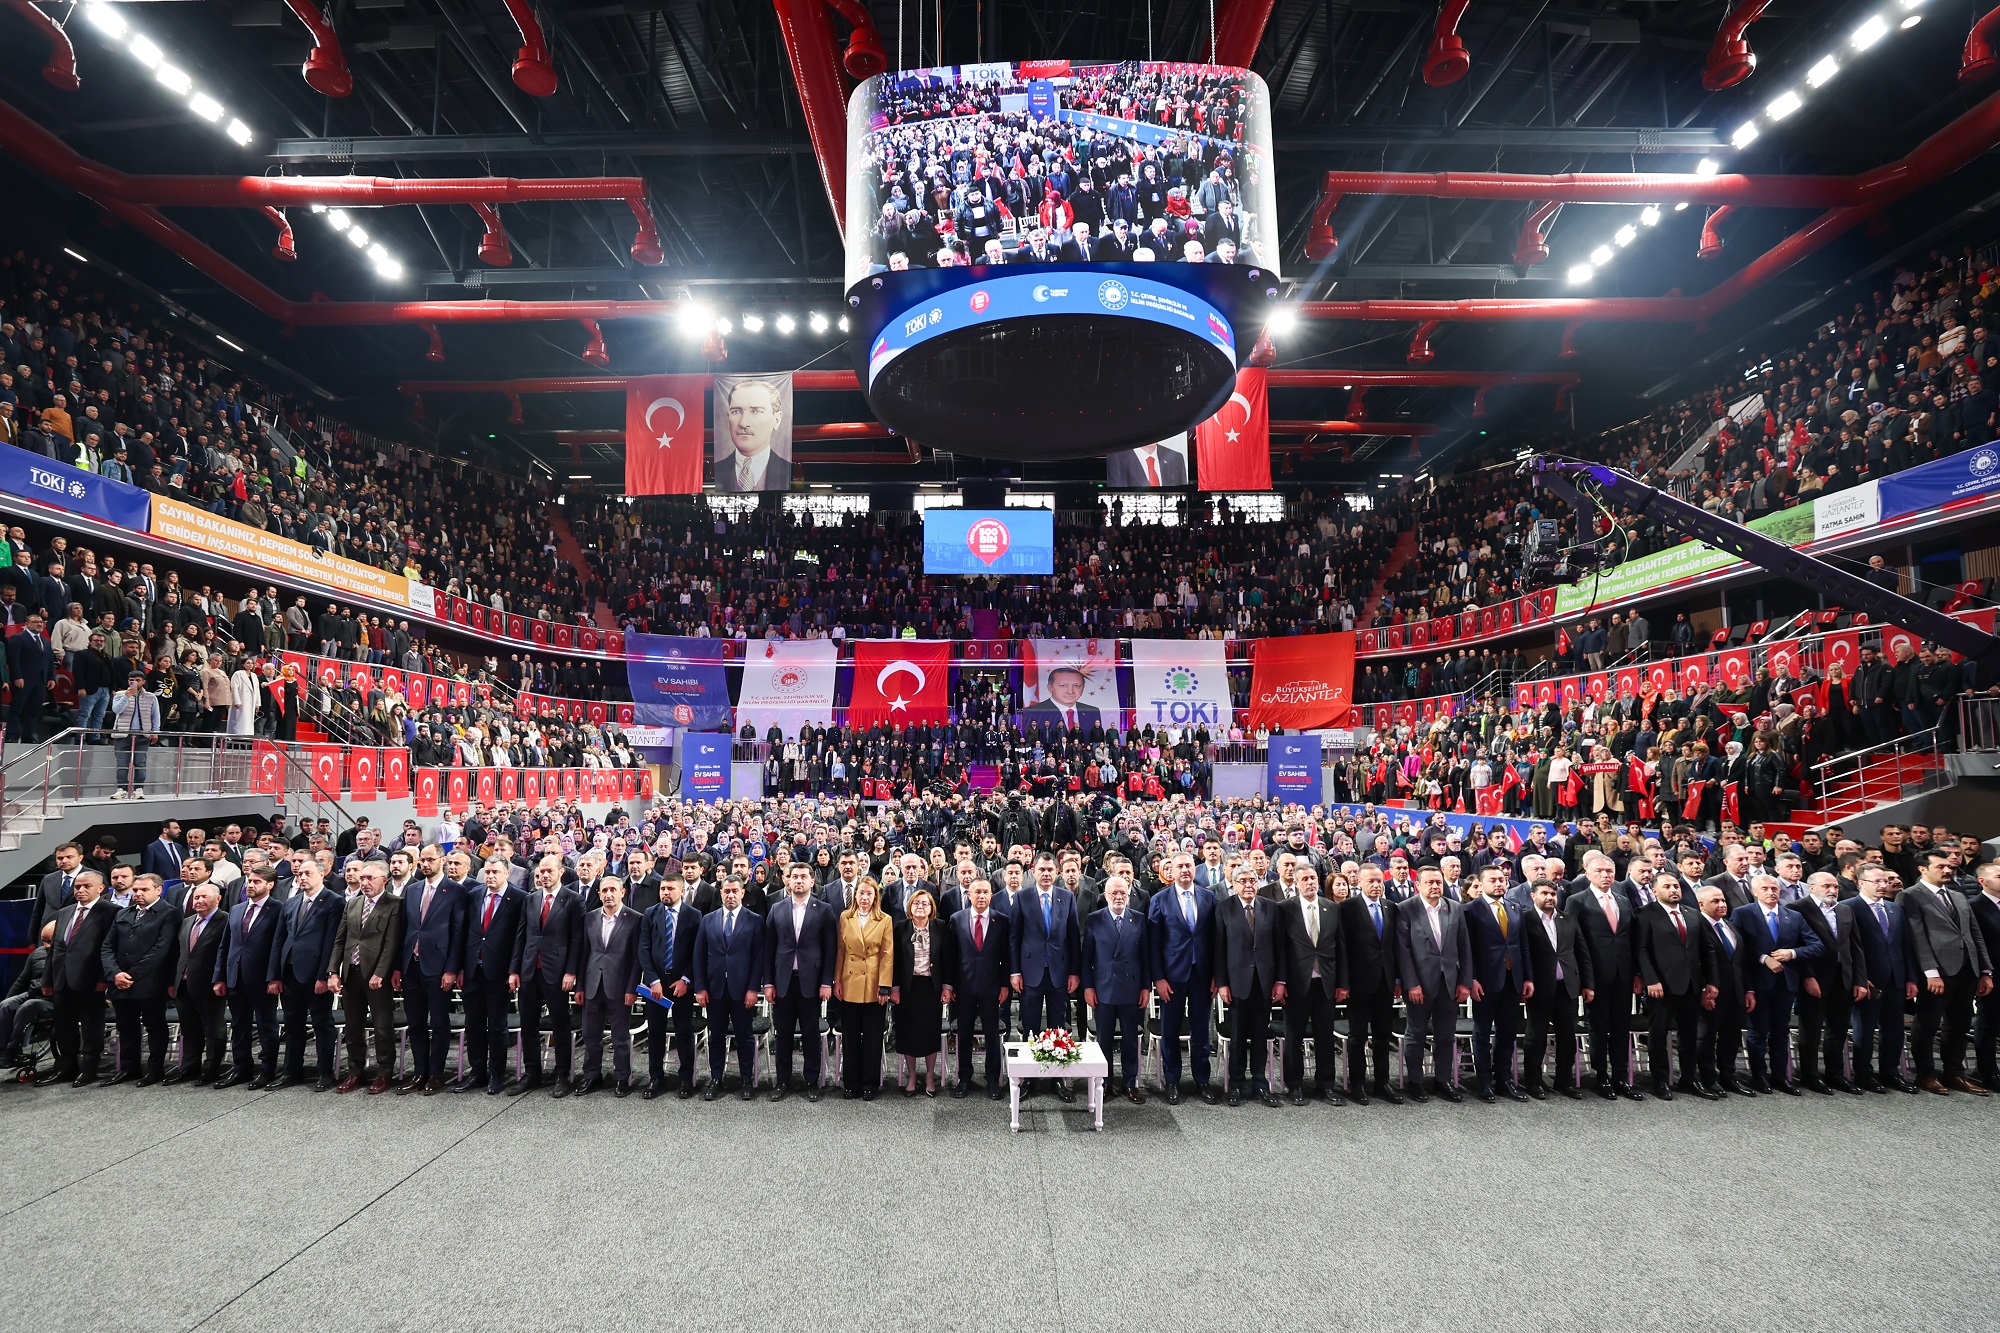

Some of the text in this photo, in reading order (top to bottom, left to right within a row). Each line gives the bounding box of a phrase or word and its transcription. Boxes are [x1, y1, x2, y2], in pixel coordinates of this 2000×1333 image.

[159, 502, 195, 525] SAYIN
[196, 514, 258, 547] BAKANIMIZ,
[259, 535, 297, 557] DEPREM
[978, 527, 999, 536] 500
[1821, 519, 1843, 531] FATMA
[158, 520, 206, 544] YENİDEN
[207, 533, 254, 560] İNŞASINA
[254, 550, 303, 574] VERDİĞİNİZ
[303, 564, 333, 582] DESTEK
[333, 572, 348, 588] İÇİN
[349, 577, 383, 598] TEŞEKKÜR
[383, 589, 405, 603] EDERİZ
[1625, 547, 1687, 577] GAZİANTEP'TE
[1602, 587, 1611, 597] VE
[1611, 576, 1645, 593] UMUTLAR
[1645, 571, 1660, 584] İÇİN
[1661, 559, 1701, 580] TEŞEKKÜR
[657, 676, 669, 684] EV
